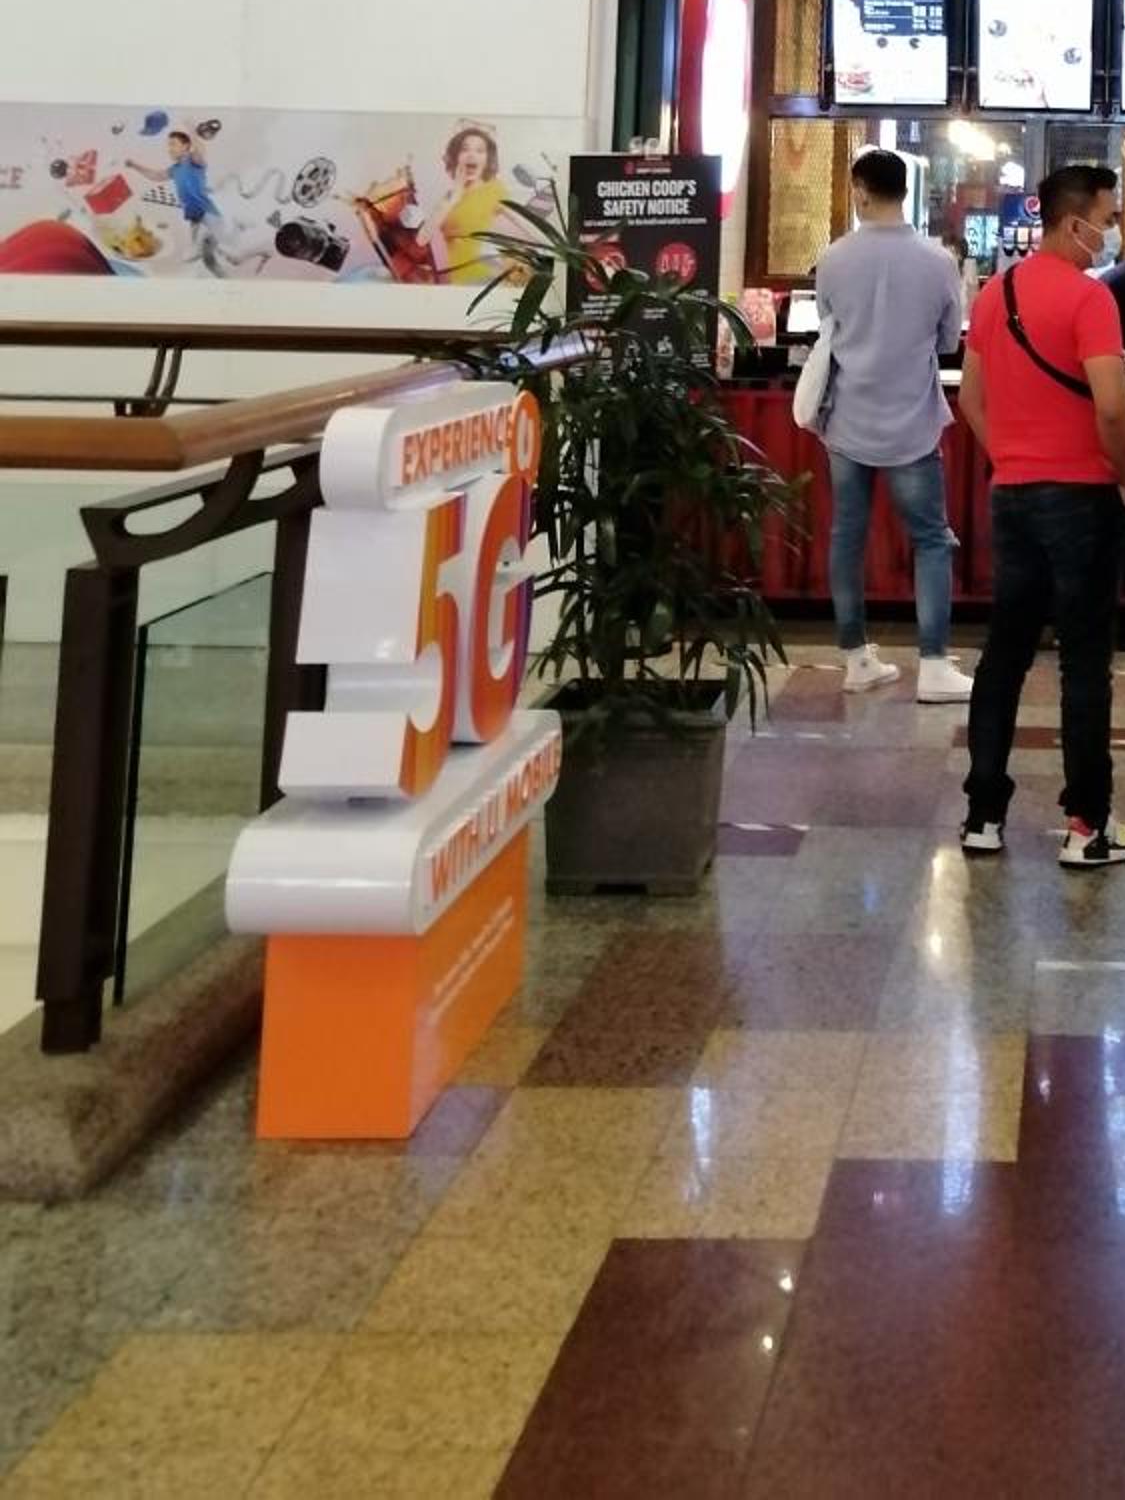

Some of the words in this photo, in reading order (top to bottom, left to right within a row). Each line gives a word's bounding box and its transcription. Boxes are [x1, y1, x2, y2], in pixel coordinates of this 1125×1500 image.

[597, 180, 651, 198] CHICKEN
[651, 179, 697, 197] COOP'S
[603, 199, 646, 217] SAFETY
[647, 197, 690, 215] NOTICE
[398, 473, 537, 799] 5G
[432, 810, 481, 903] WITH
